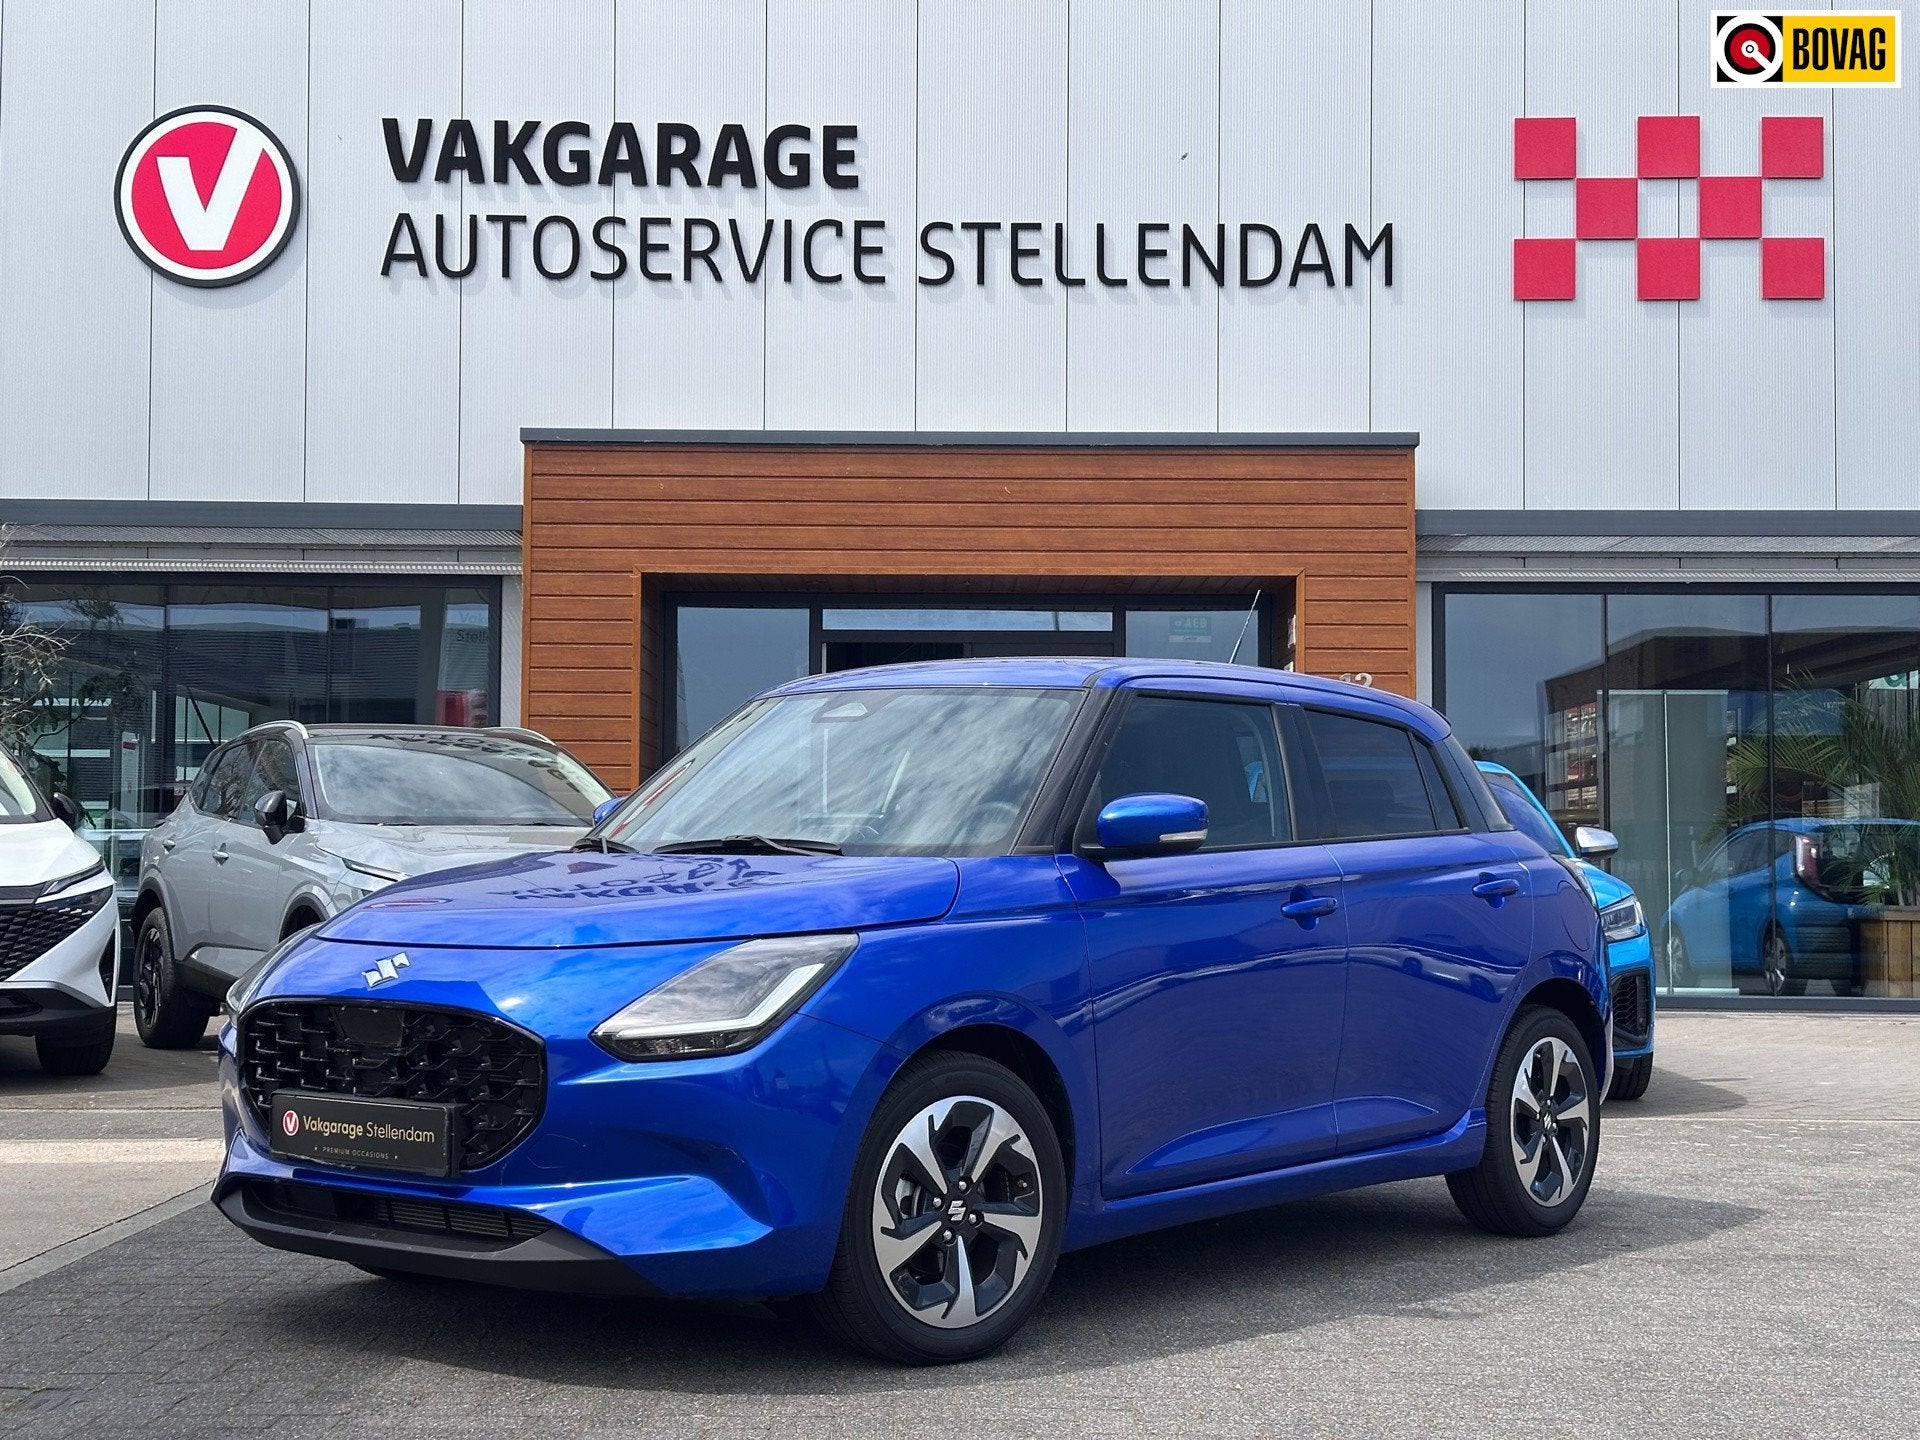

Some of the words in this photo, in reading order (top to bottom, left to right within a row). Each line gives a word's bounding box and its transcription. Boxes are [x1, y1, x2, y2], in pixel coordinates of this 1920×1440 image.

[381, 117, 860, 190] VAKGARAGE
[380, 212, 887, 284] AUTOSERVICE
[918, 221, 1394, 287] STELLENDAM
[303, 1115, 364, 1139] Vakgarage
[366, 1121, 435, 1143] Stellendam
[322, 1145, 350, 1156] PREMIUM
[352, 1149, 389, 1160] OCCASIONS
